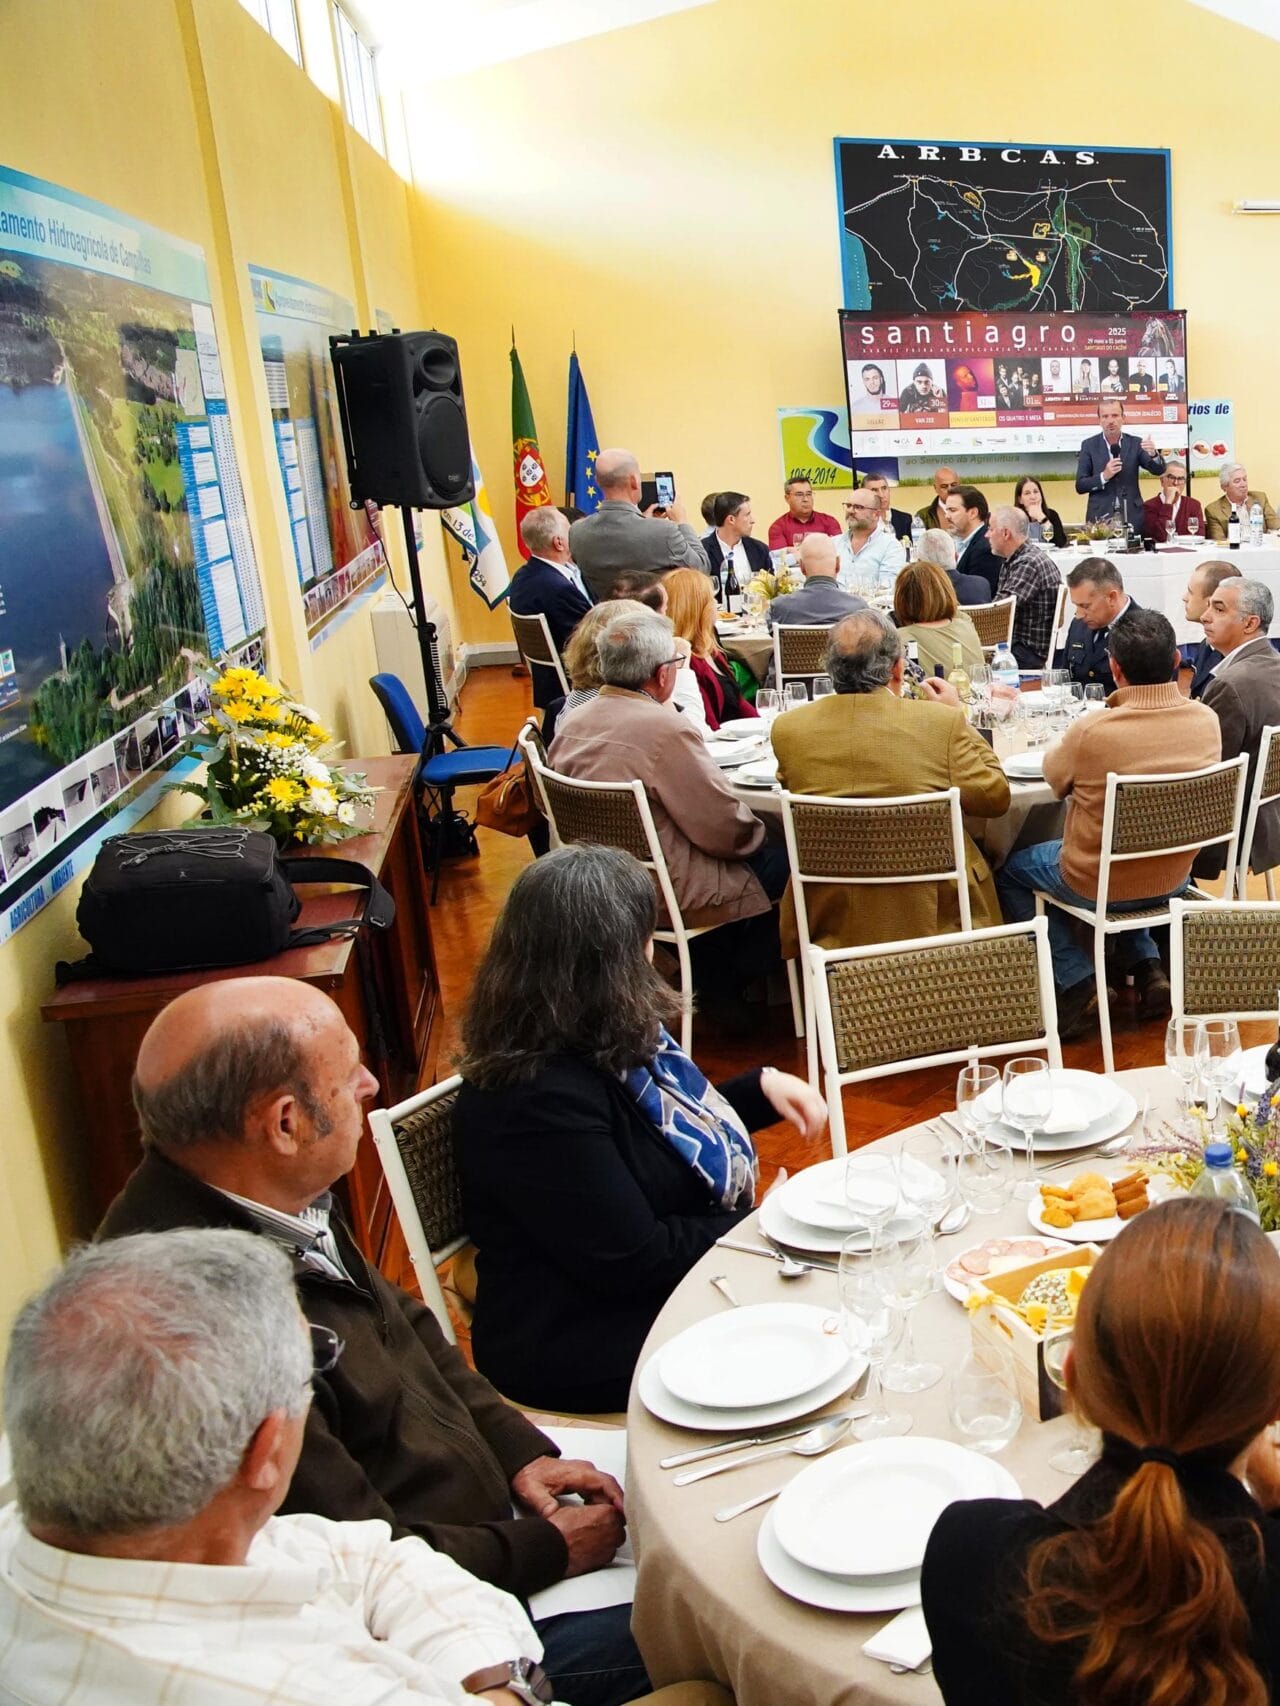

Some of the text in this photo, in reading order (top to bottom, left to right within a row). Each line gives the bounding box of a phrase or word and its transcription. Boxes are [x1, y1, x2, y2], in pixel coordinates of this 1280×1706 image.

[0, 209, 46, 243] amento
[110, 239, 119, 264] de
[861, 320, 1076, 348] santiagro
[1108, 327, 1127, 336] 2025
[1215, 403, 1229, 415] de
[453, 519, 464, 532] 13
[463, 528, 474, 541] de
